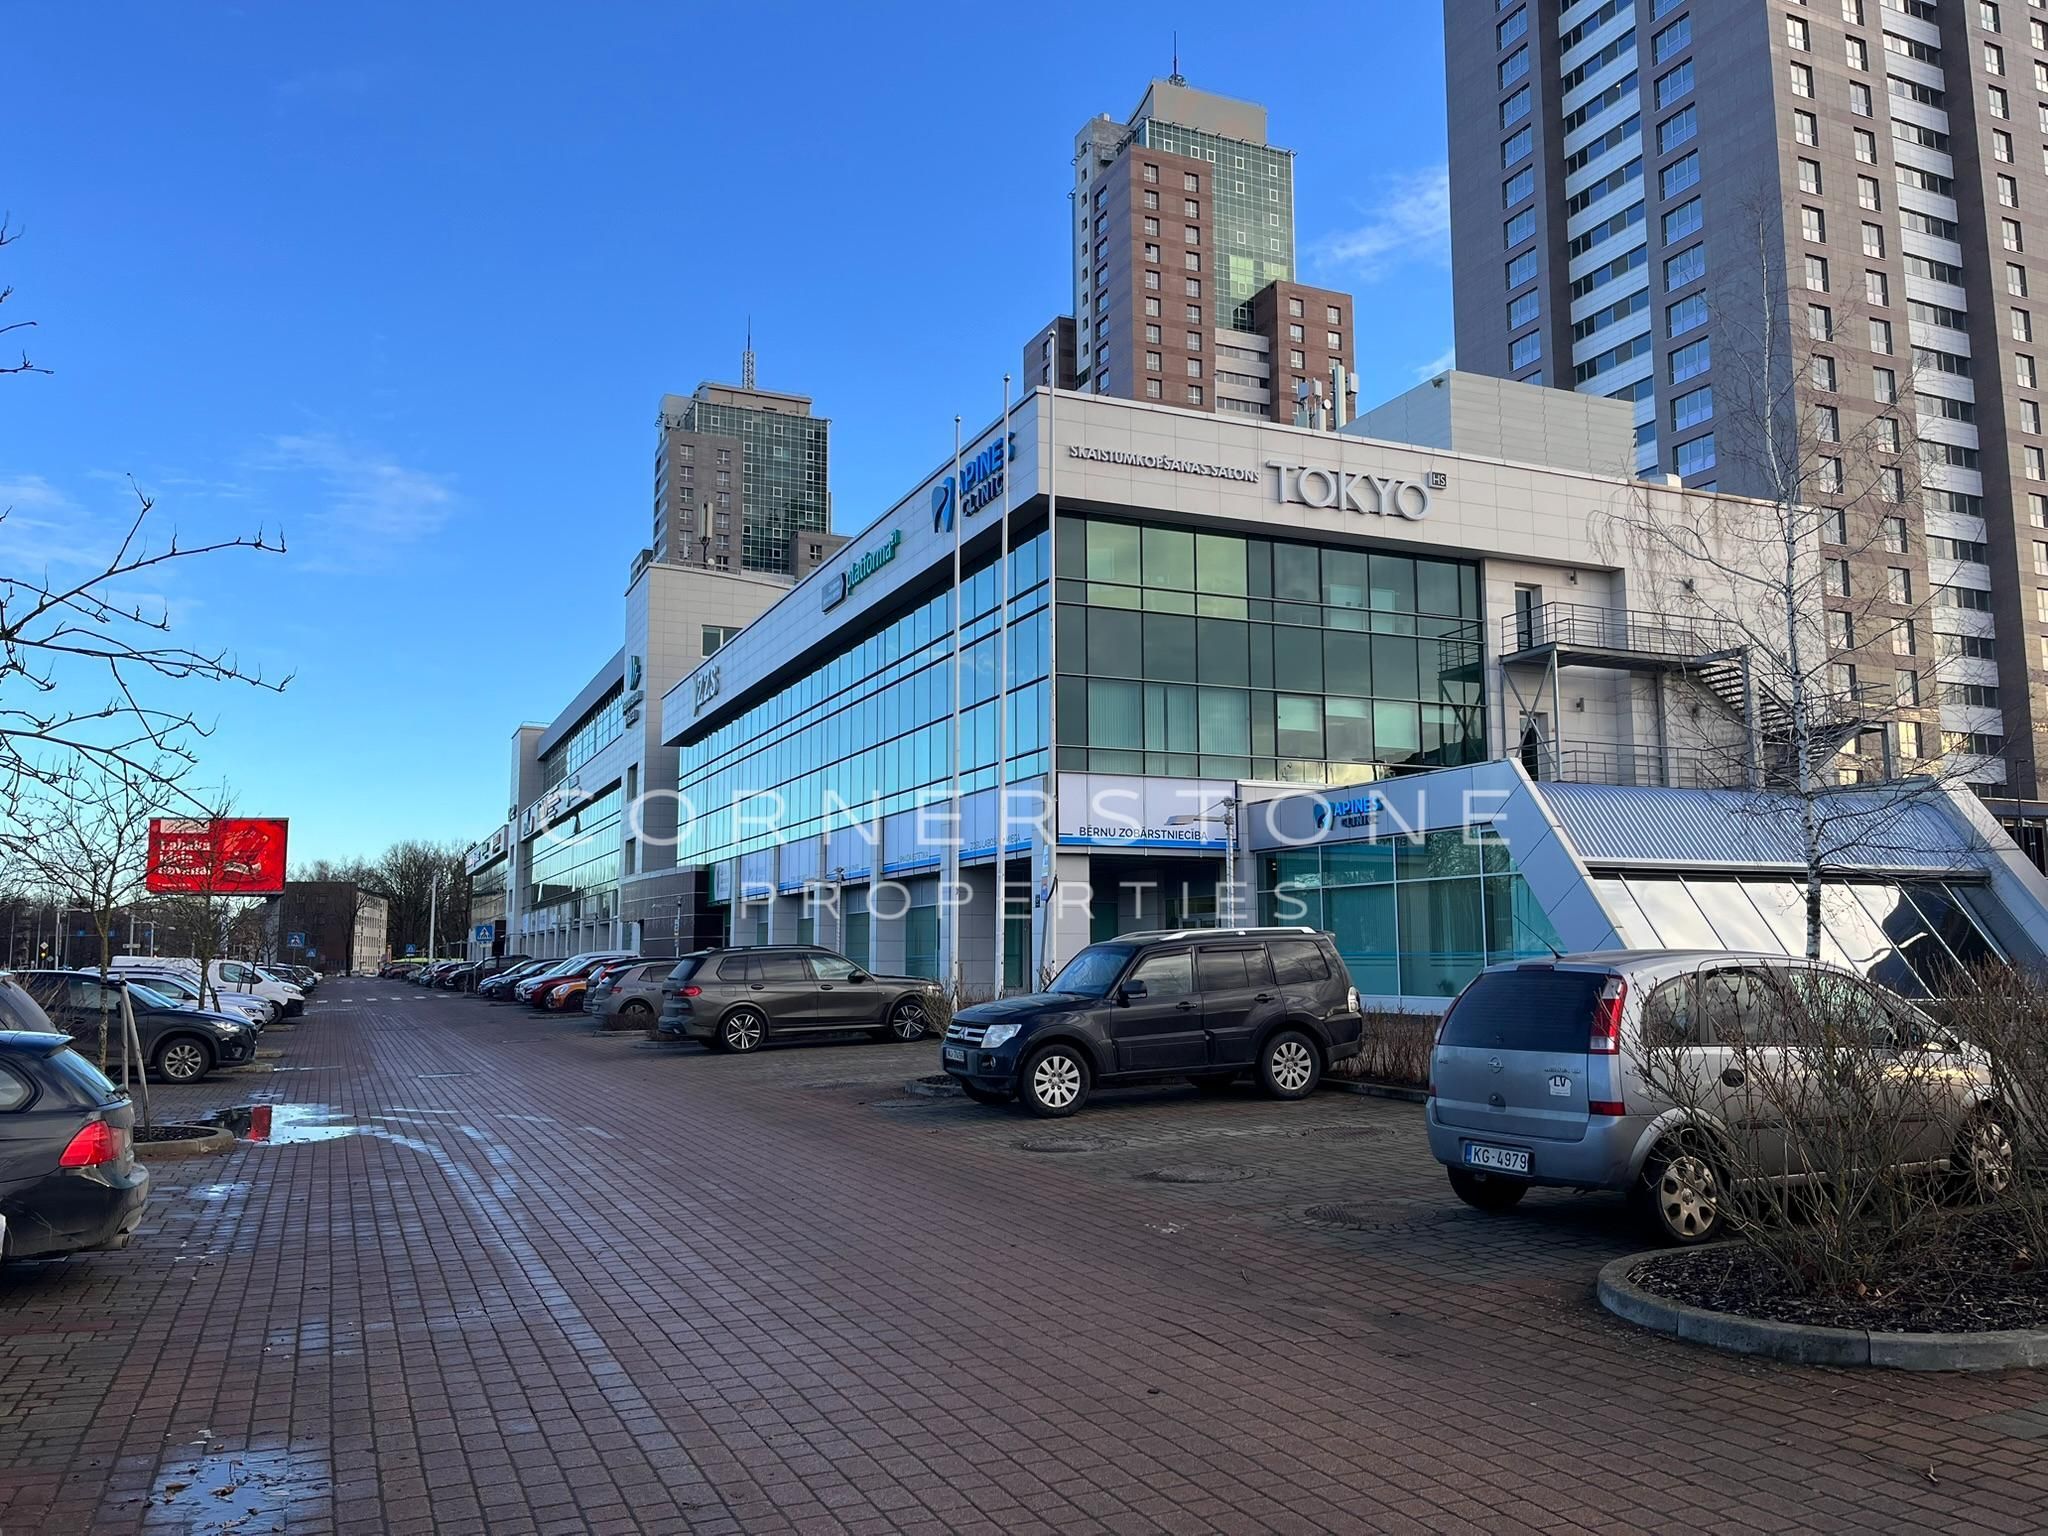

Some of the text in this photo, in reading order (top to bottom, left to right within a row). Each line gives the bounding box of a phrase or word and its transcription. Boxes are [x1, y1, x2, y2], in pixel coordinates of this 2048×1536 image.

[1210, 464, 1261, 483] SALONS
[1433, 474, 1446, 486] HS
[1266, 459, 1432, 521] TOKYO
[1079, 824, 1208, 841] BĒRNU ZOBĀRSTNIECĪBA
[1554, 1076, 1567, 1087] LV
[1473, 1149, 1527, 1171] KG-4979
